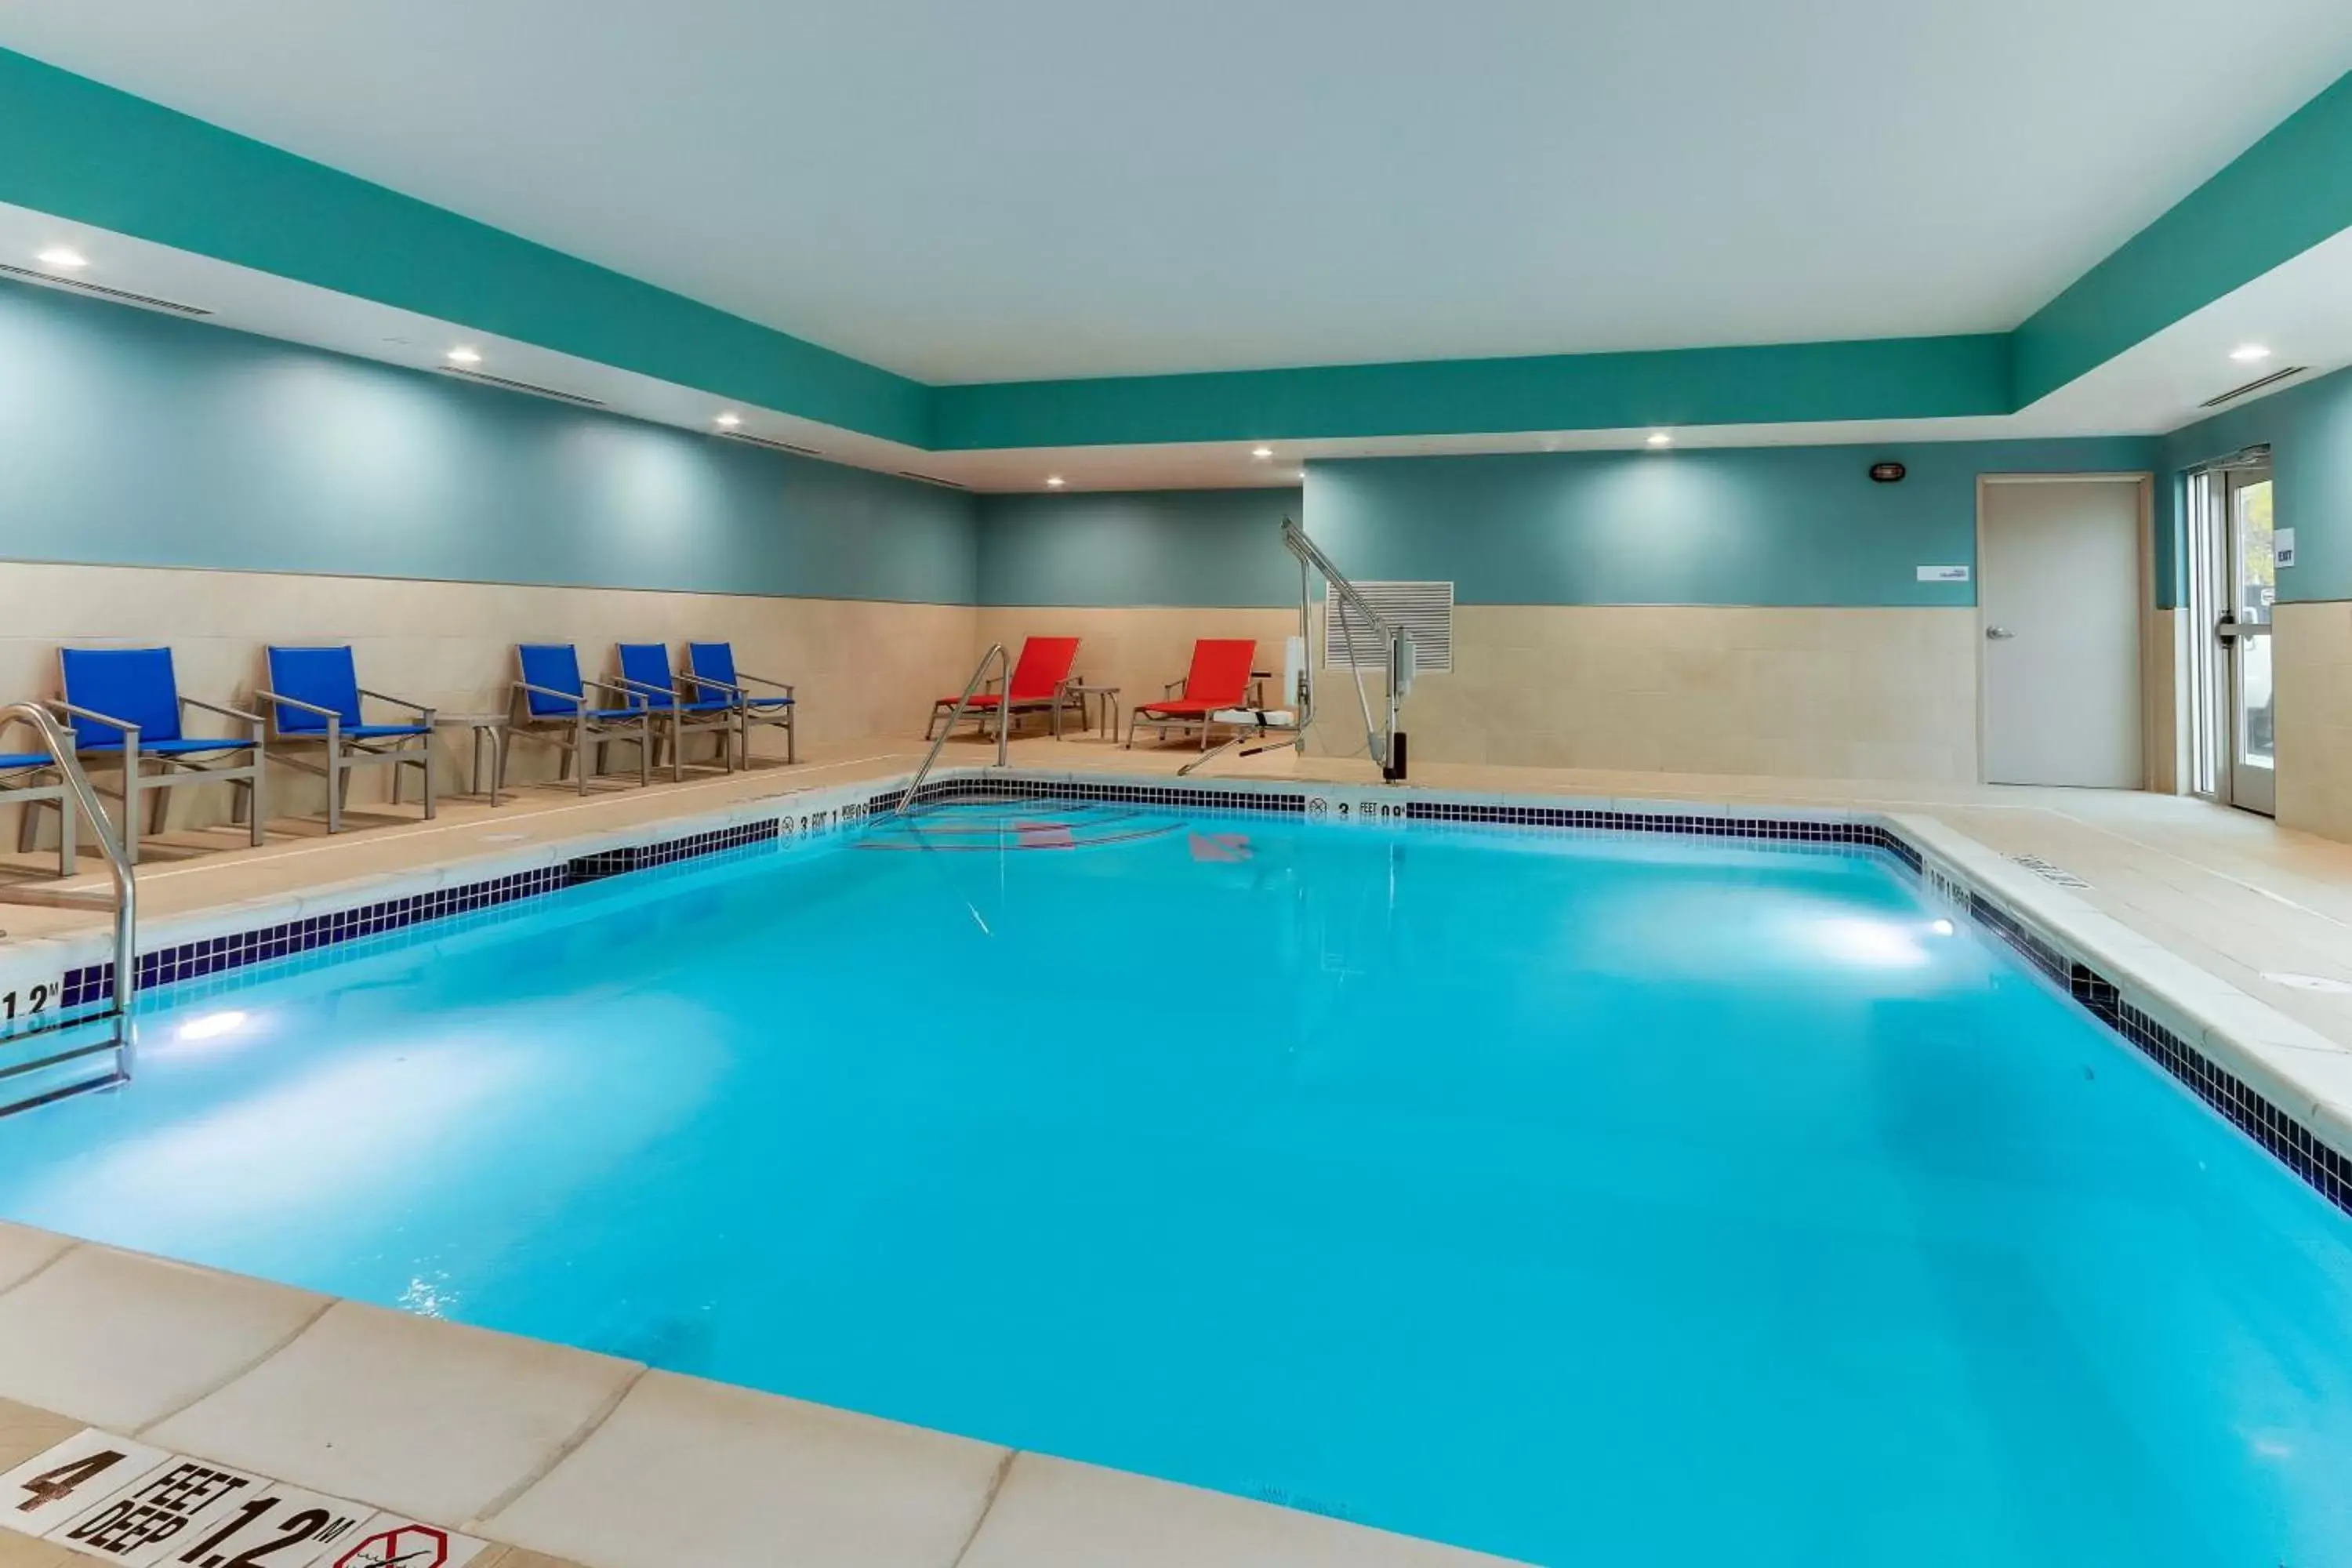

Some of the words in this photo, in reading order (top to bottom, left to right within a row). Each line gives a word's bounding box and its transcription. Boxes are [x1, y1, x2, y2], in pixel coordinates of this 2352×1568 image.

[2278, 550, 2292, 561] EXIT
[1360, 802, 1377, 813] FEET
[14, 1450, 127, 1513] 4
[132, 1463, 250, 1515] FEET
[66, 1500, 190, 1556] DEEP
